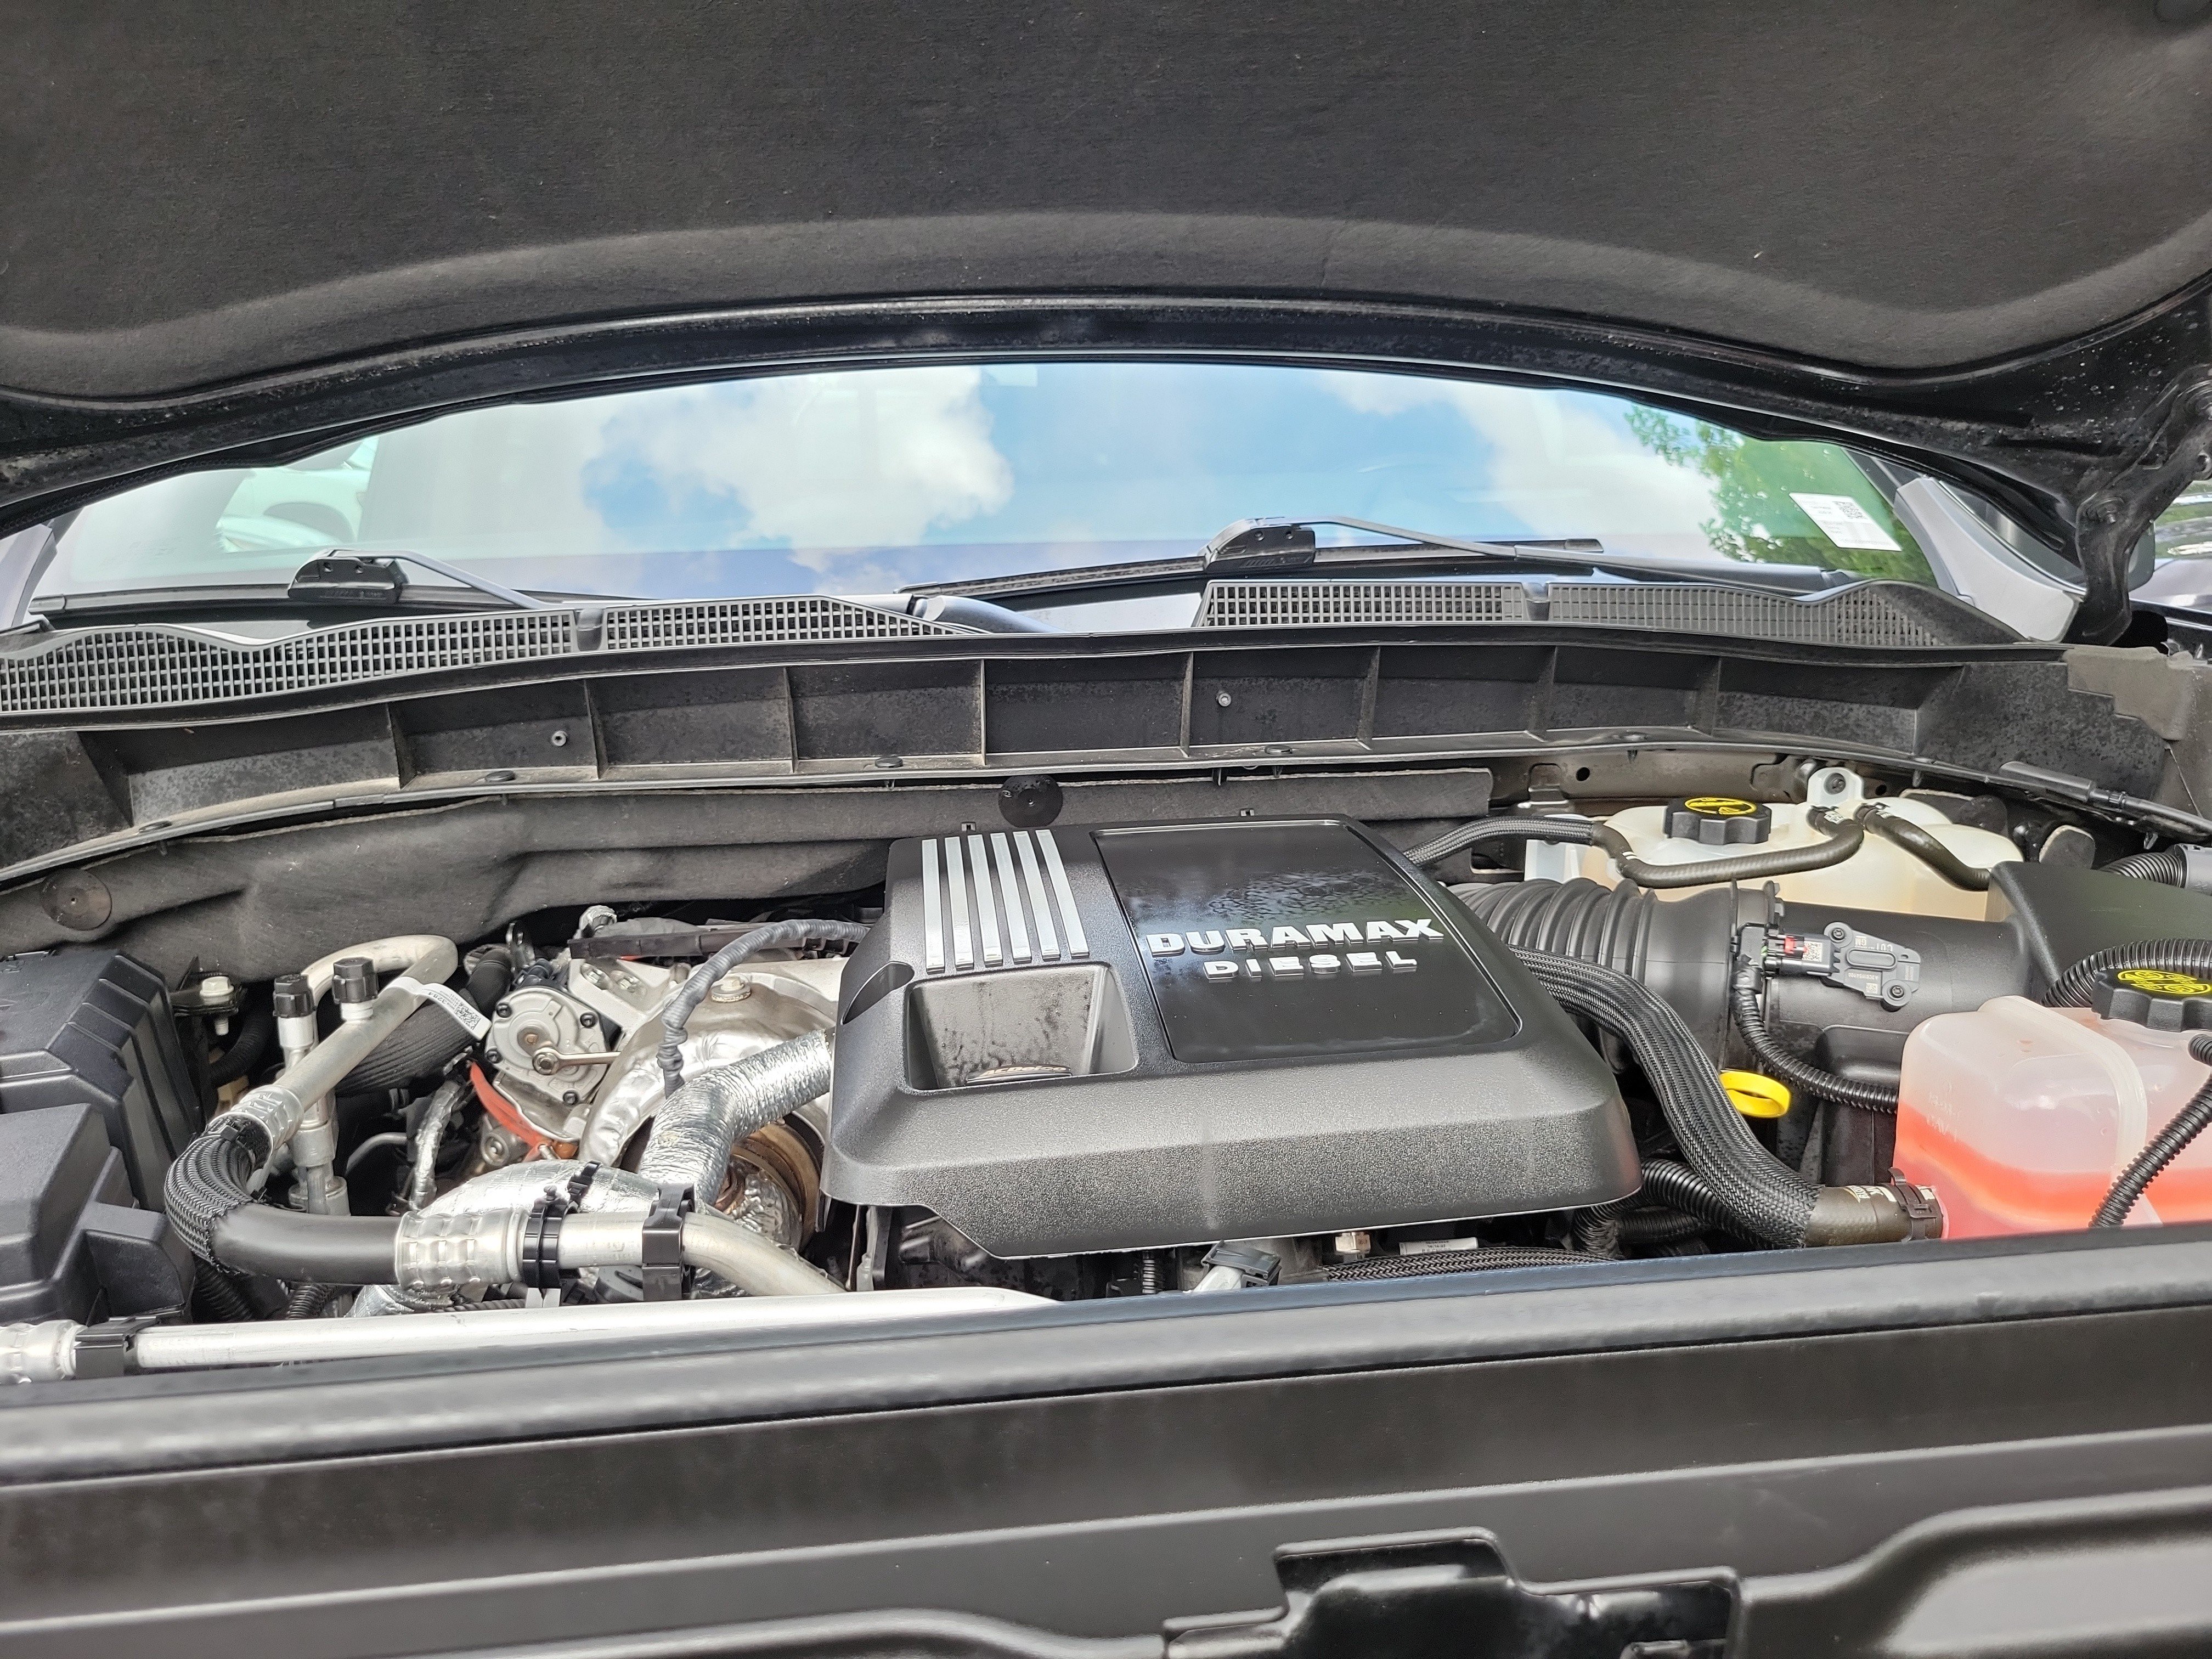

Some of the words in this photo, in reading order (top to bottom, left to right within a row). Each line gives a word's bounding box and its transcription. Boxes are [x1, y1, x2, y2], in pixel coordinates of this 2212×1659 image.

[1146, 918, 1444, 956] DURAMAX
[1855, 937, 1866, 945] GM
[1203, 951, 1417, 980] DIESEL
